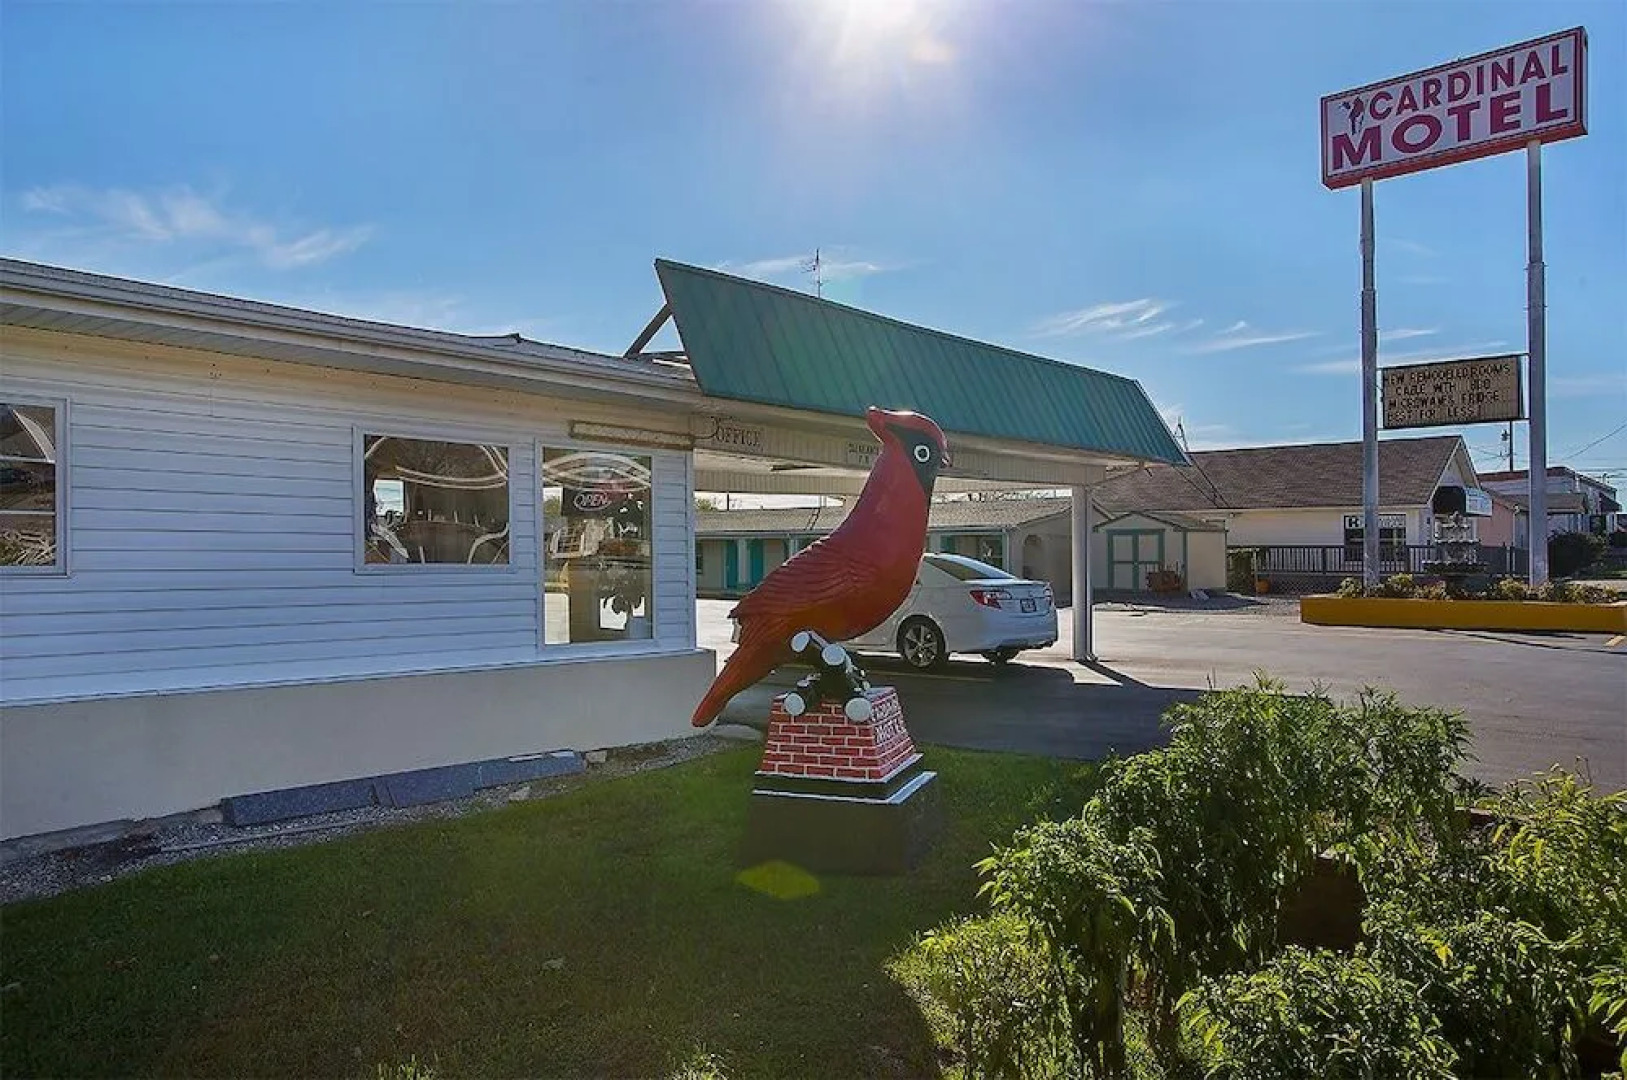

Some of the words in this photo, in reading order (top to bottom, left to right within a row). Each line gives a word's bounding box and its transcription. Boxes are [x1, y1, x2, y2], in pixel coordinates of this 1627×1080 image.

[1369, 44, 1568, 121] CARDINAL
[1331, 82, 1568, 170] MOTEL
[1395, 384, 1425, 396] CABLE
[1433, 382, 1456, 394] WITH
[716, 426, 761, 447] OFFICE
